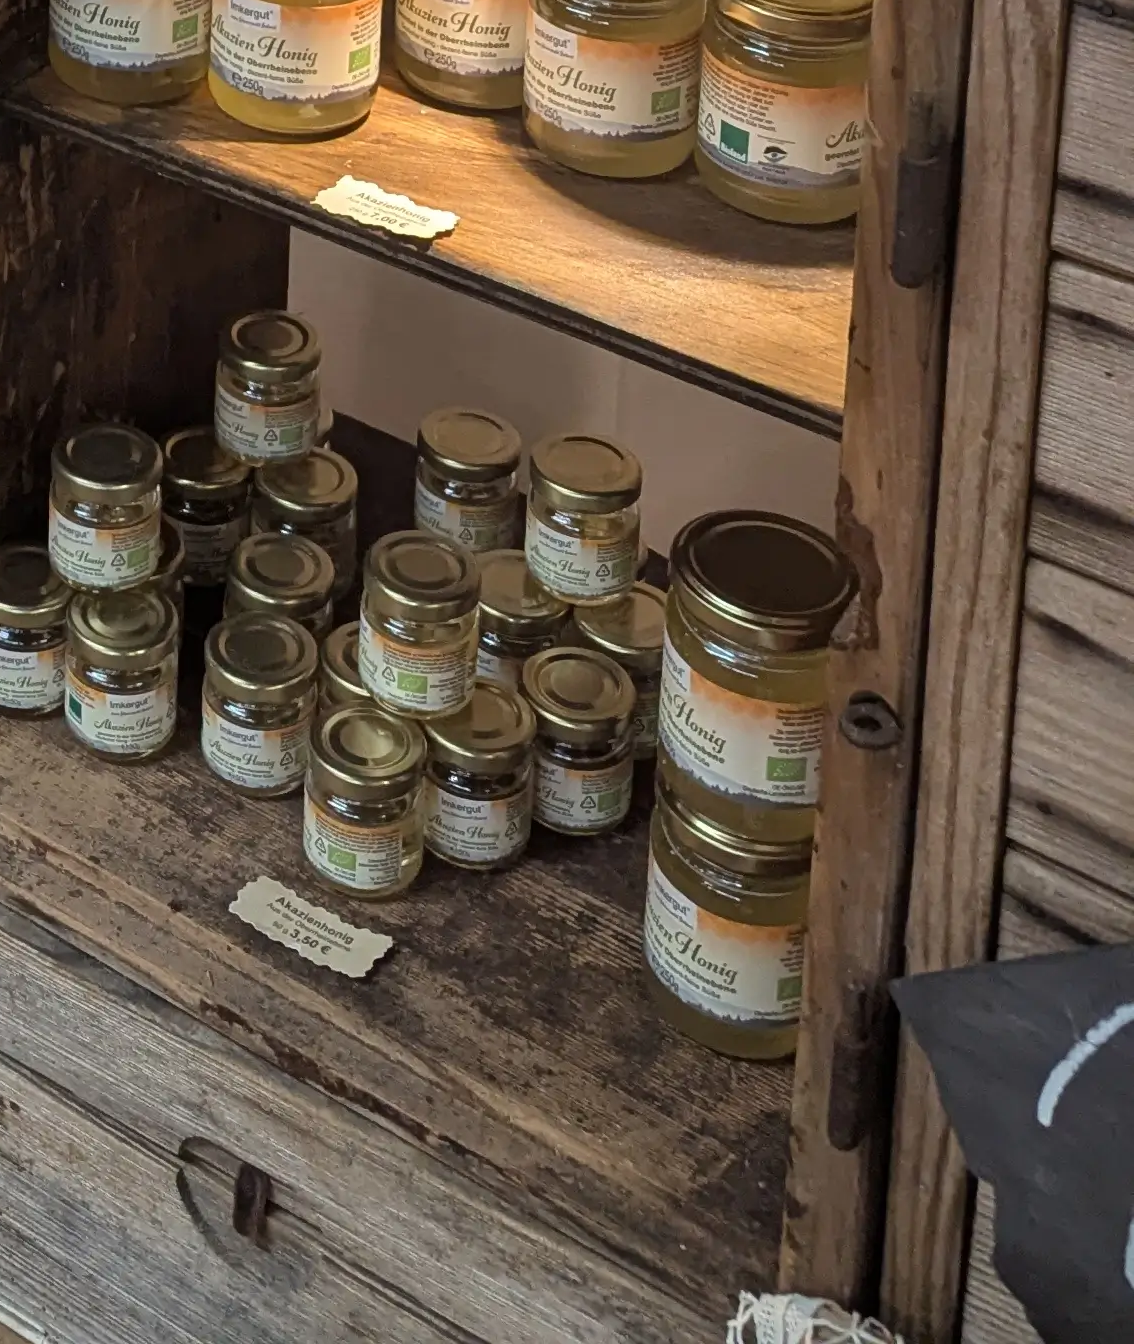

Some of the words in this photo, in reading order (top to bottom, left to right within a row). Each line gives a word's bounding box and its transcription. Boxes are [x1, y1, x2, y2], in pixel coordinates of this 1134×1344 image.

[356, 192, 431, 222] Akazienhonig
[674, 691, 727, 755] Honig
[275, 896, 355, 945] Akazienhonig
[290, 928, 319, 948] 3,50
[320, 945, 332, 955] €
[675, 931, 738, 986] Honig
